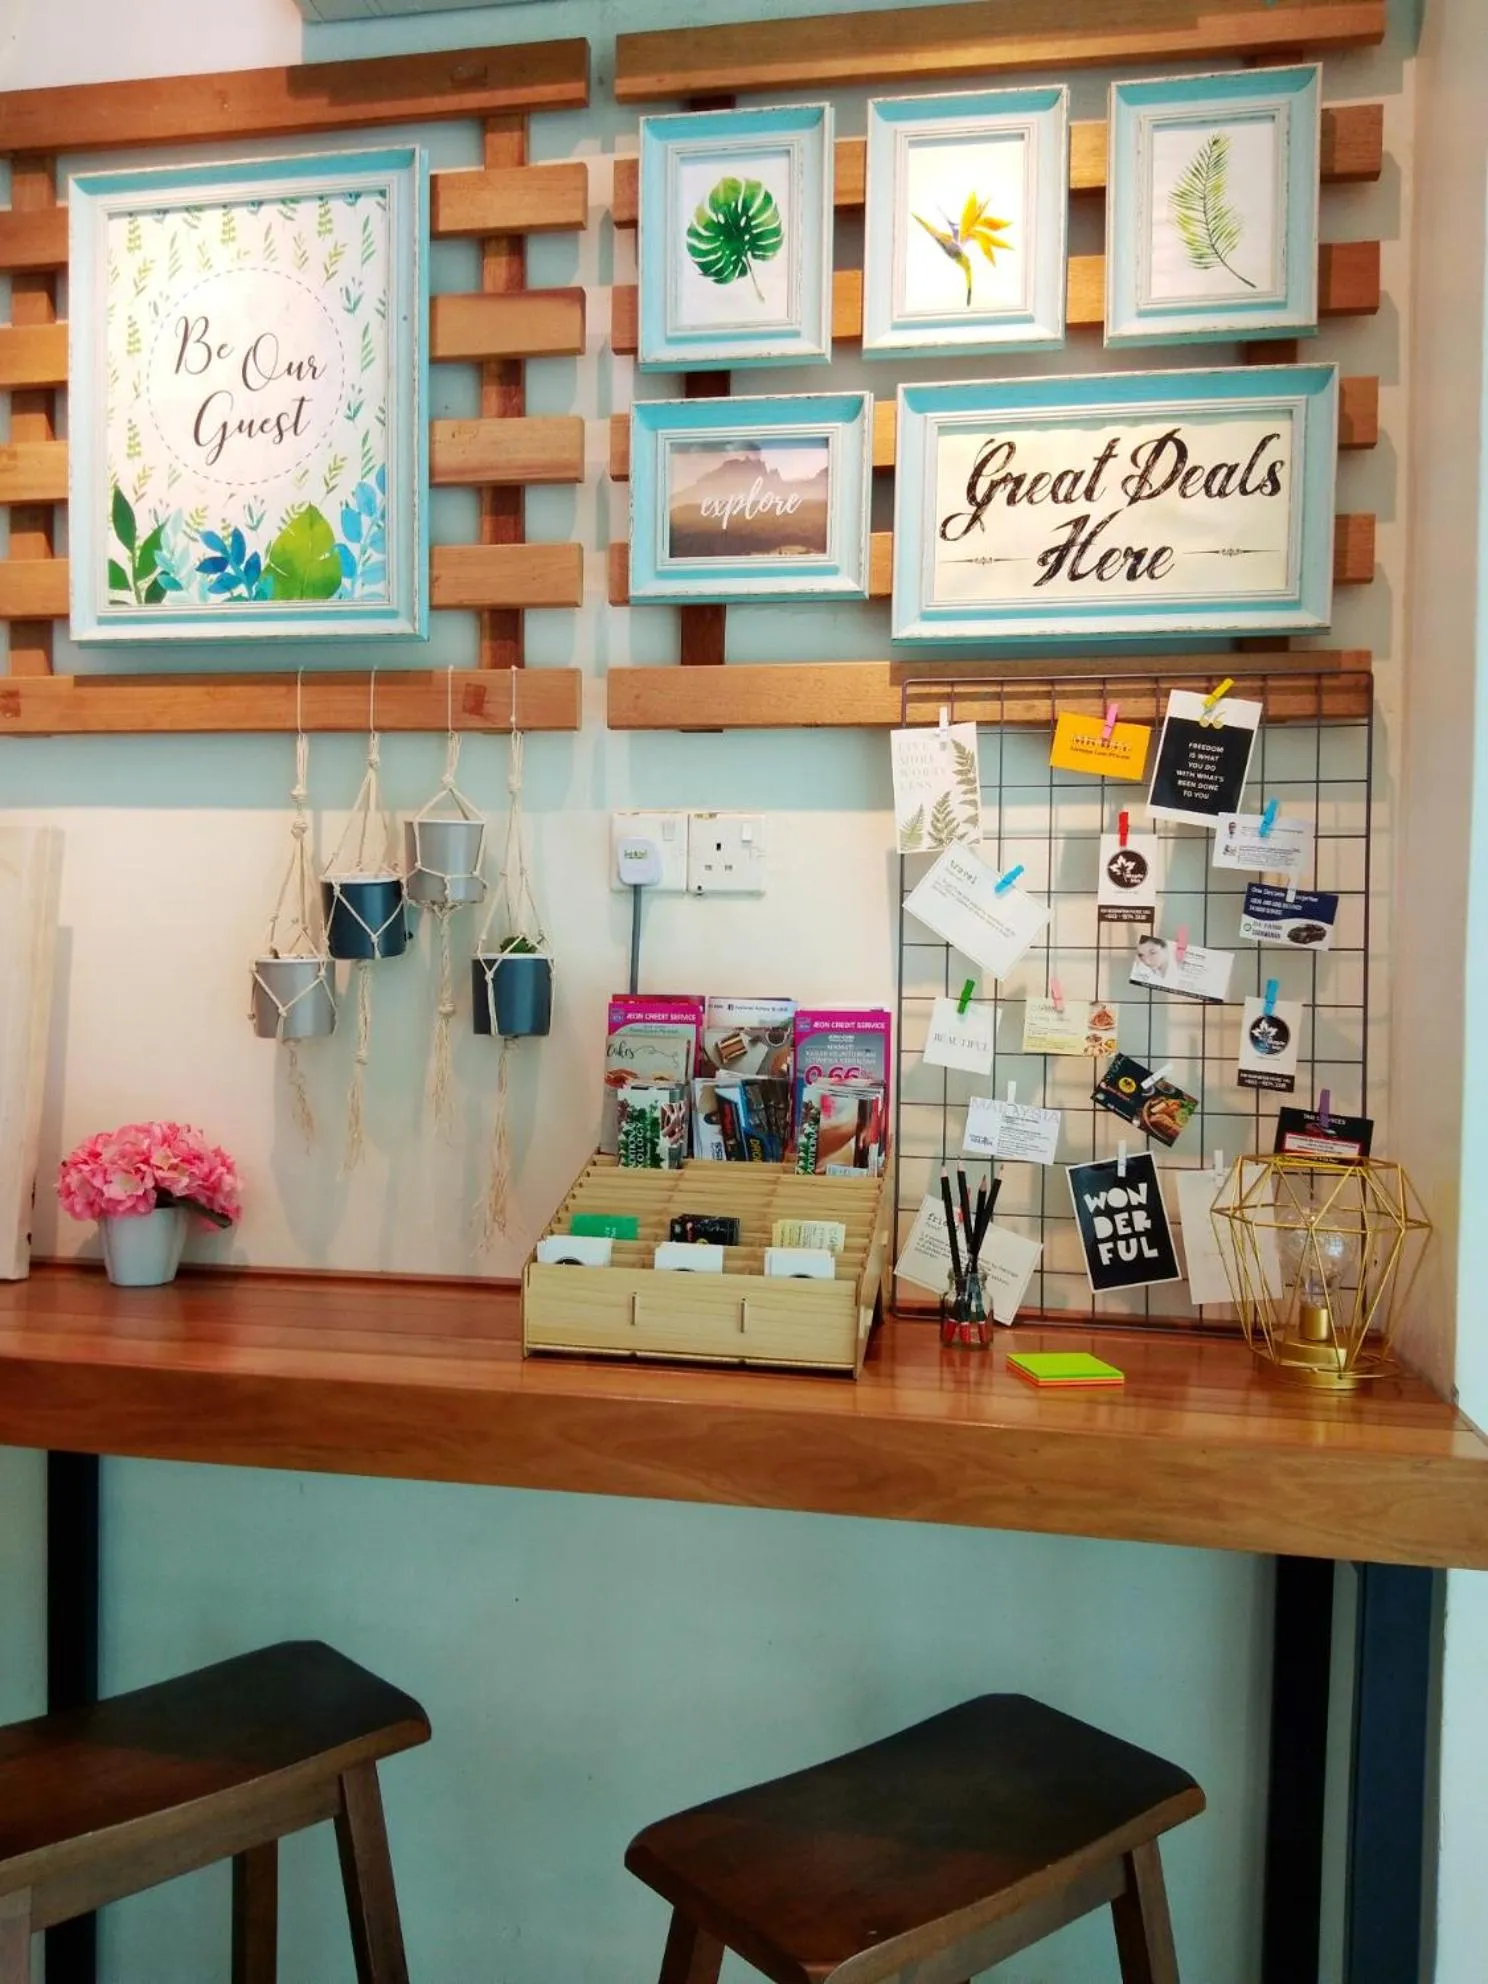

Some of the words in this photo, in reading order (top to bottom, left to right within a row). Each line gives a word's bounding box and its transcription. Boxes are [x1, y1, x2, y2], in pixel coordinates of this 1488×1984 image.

[174, 315, 236, 376] Be
[241, 332, 328, 392] Our
[193, 389, 314, 467] Guest
[939, 436, 1121, 542] Great
[1120, 427, 1286, 508] Deals
[700, 475, 802, 530] explore
[1032, 507, 1176, 588] Here
[1188, 742, 1225, 753] FREEDOM
[1197, 753, 1219, 762] WHAT
[1176, 769, 1196, 779] WITH
[1188, 761, 1204, 770] YOU
[1204, 764, 1217, 772] DO
[1177, 779, 1197, 788] BEEN
[1197, 781, 1220, 791] DONE
[1194, 791, 1210, 800] YOU
[645, 1012, 669, 1021] CREDIT
[670, 1013, 697, 1022] SERVICE
[831, 1021, 856, 1030] CREDIT
[857, 1021, 886, 1031] SERVICE
[1082, 1182, 1149, 1213] WON
[1092, 1209, 1153, 1239] DER
[1097, 1235, 1160, 1266] FUL
